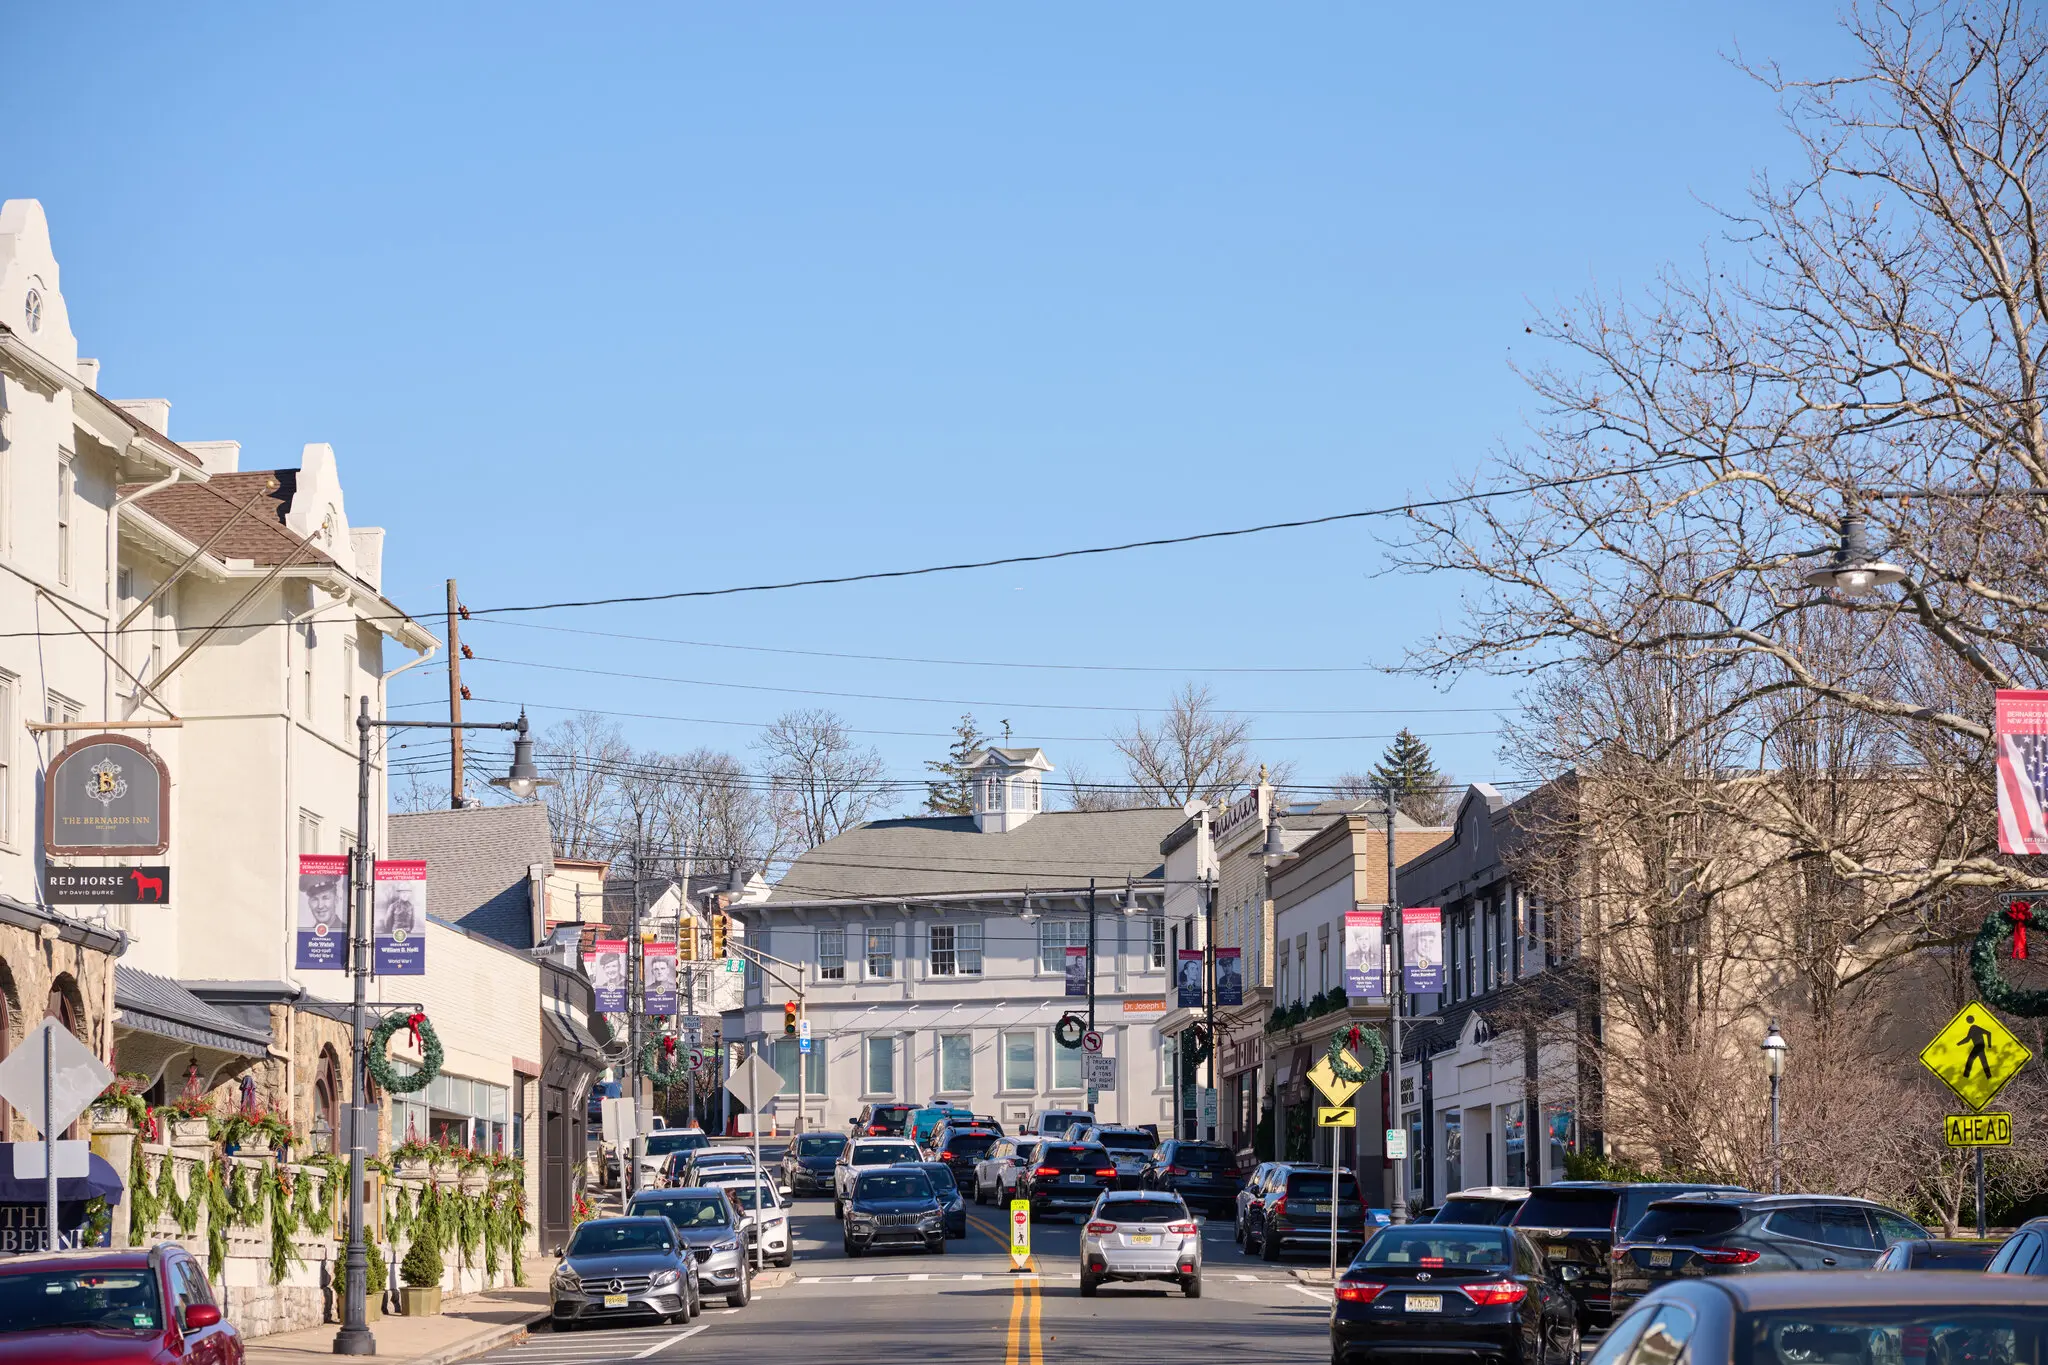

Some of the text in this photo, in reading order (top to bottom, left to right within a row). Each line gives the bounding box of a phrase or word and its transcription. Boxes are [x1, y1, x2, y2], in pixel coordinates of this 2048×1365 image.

[62, 816, 150, 825] THE BERNARDS INN
[50, 876, 124, 886] RED HORSE
[1135, 1002, 1159, 1011] Joseph
[1951, 1118, 2008, 1142] AHEAD
